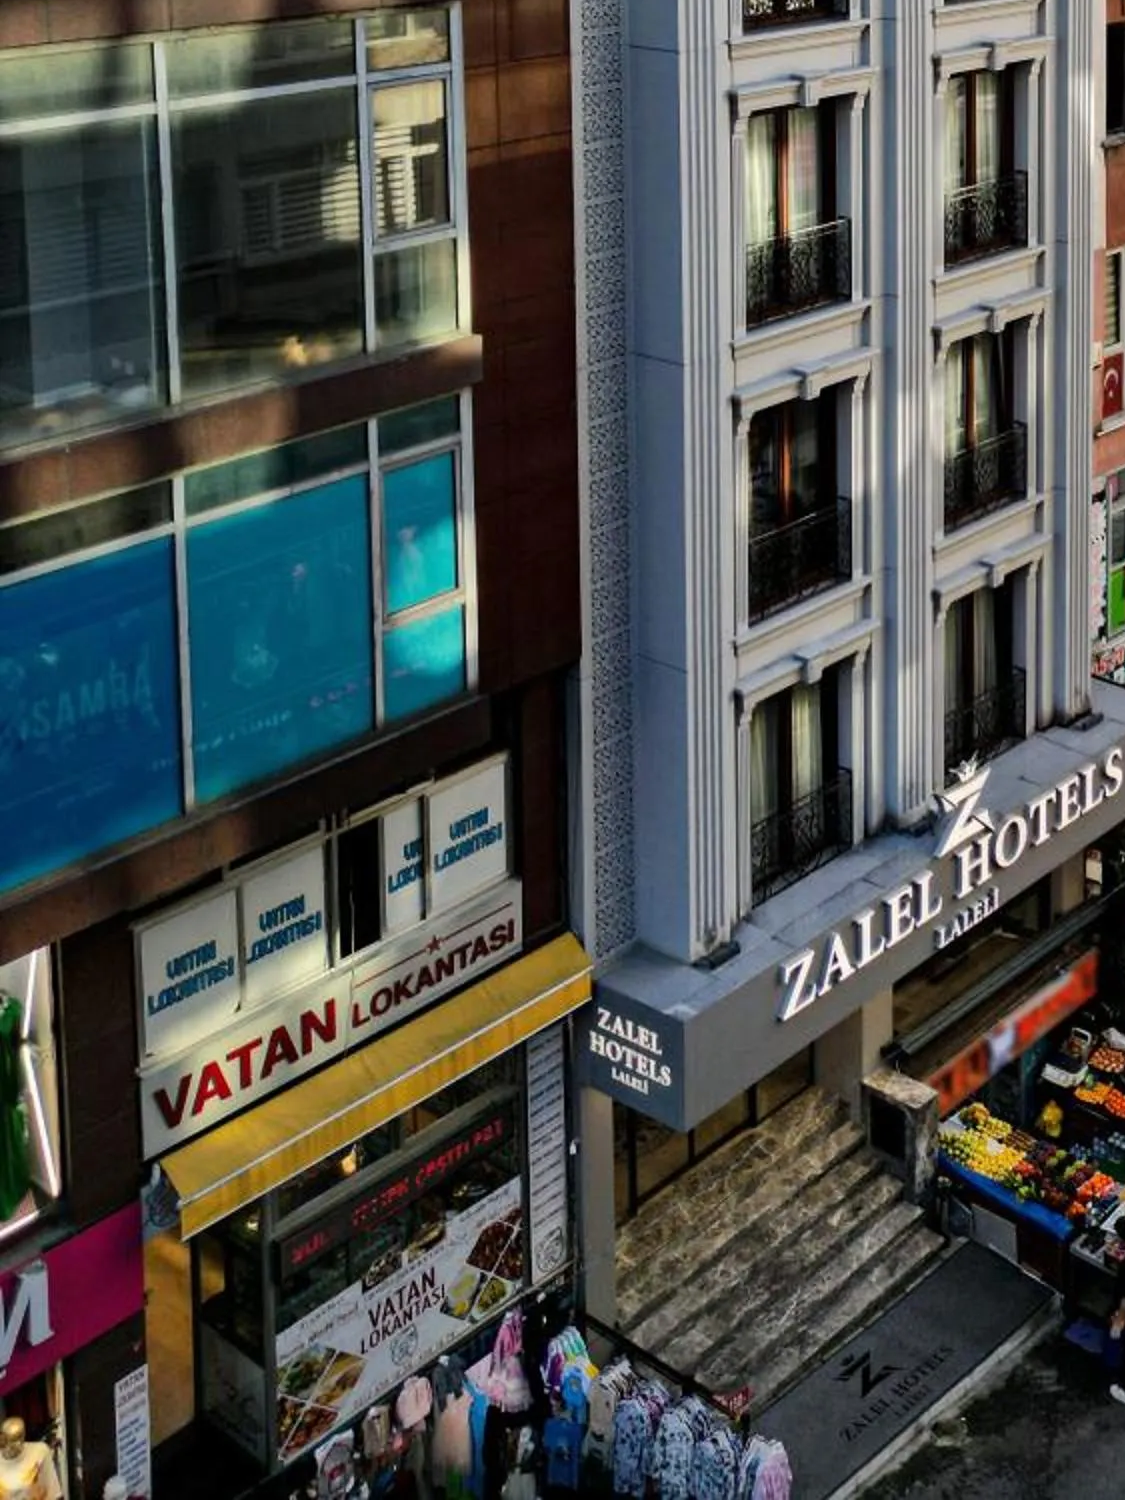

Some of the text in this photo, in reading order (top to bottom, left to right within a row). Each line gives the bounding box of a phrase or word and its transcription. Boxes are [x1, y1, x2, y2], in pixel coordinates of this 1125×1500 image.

[777, 747, 1124, 1021] ZALEL HOTELS
[153, 919, 516, 1130] VATAN LOKANTASI
[598, 1007, 663, 1056] ZALEL
[590, 1030, 672, 1087] HOTELS
[361, 1286, 448, 1354] LOKANTASI
[368, 1267, 438, 1328] VATAN
